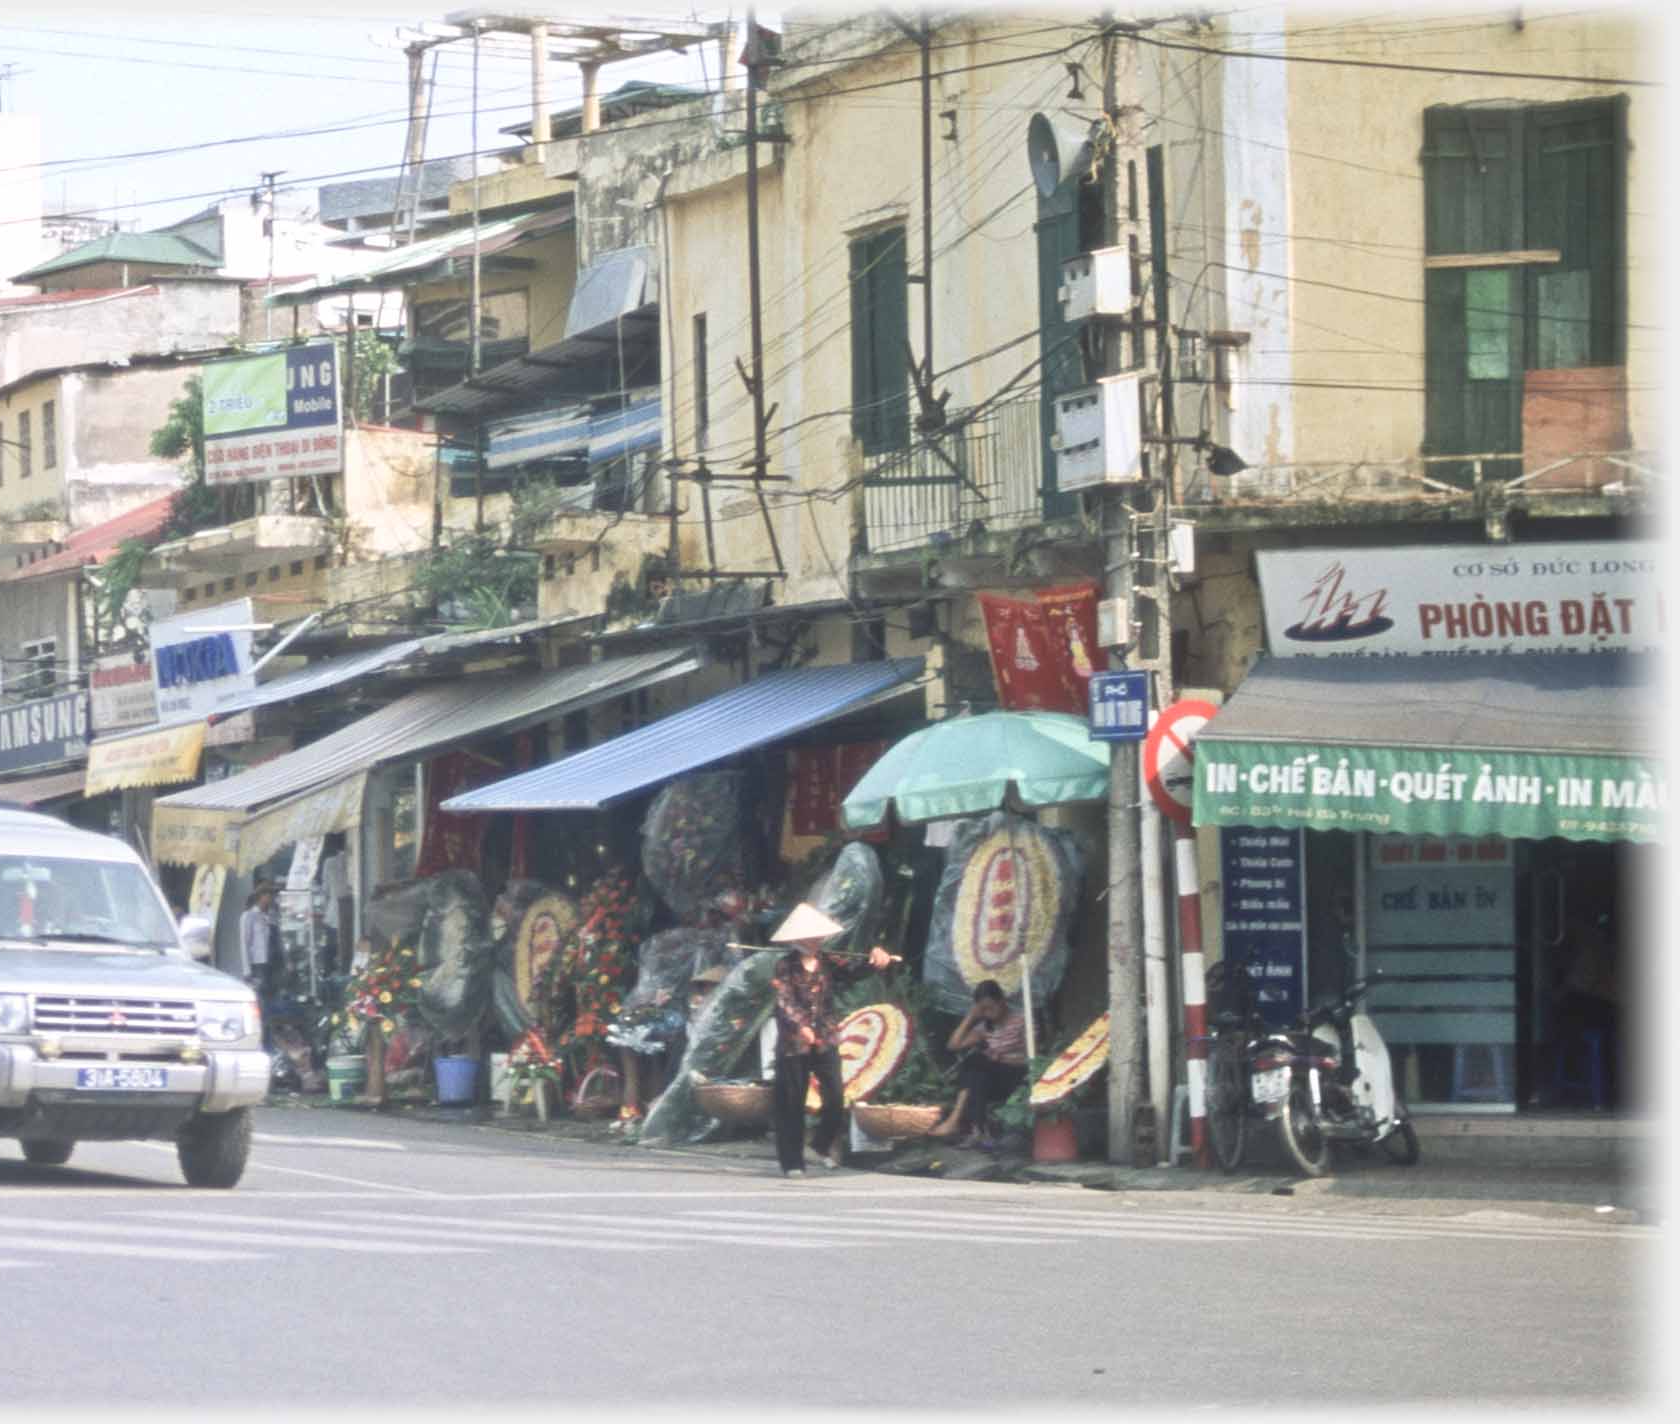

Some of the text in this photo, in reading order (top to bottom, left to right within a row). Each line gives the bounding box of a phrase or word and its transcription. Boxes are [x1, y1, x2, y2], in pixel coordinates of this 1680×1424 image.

[294, 396, 332, 414] Mobile
[1531, 555, 1581, 576] ĐỨC
[1418, 592, 1551, 640] PHÒNG
[1560, 591, 1637, 641] ĐẶT
[1206, 763, 1237, 793] IN
[1311, 758, 1376, 797] BẢN
[1389, 763, 1468, 804] QUÉT
[1472, 763, 1542, 805] ẢNH
[1557, 777, 1592, 807] IN
